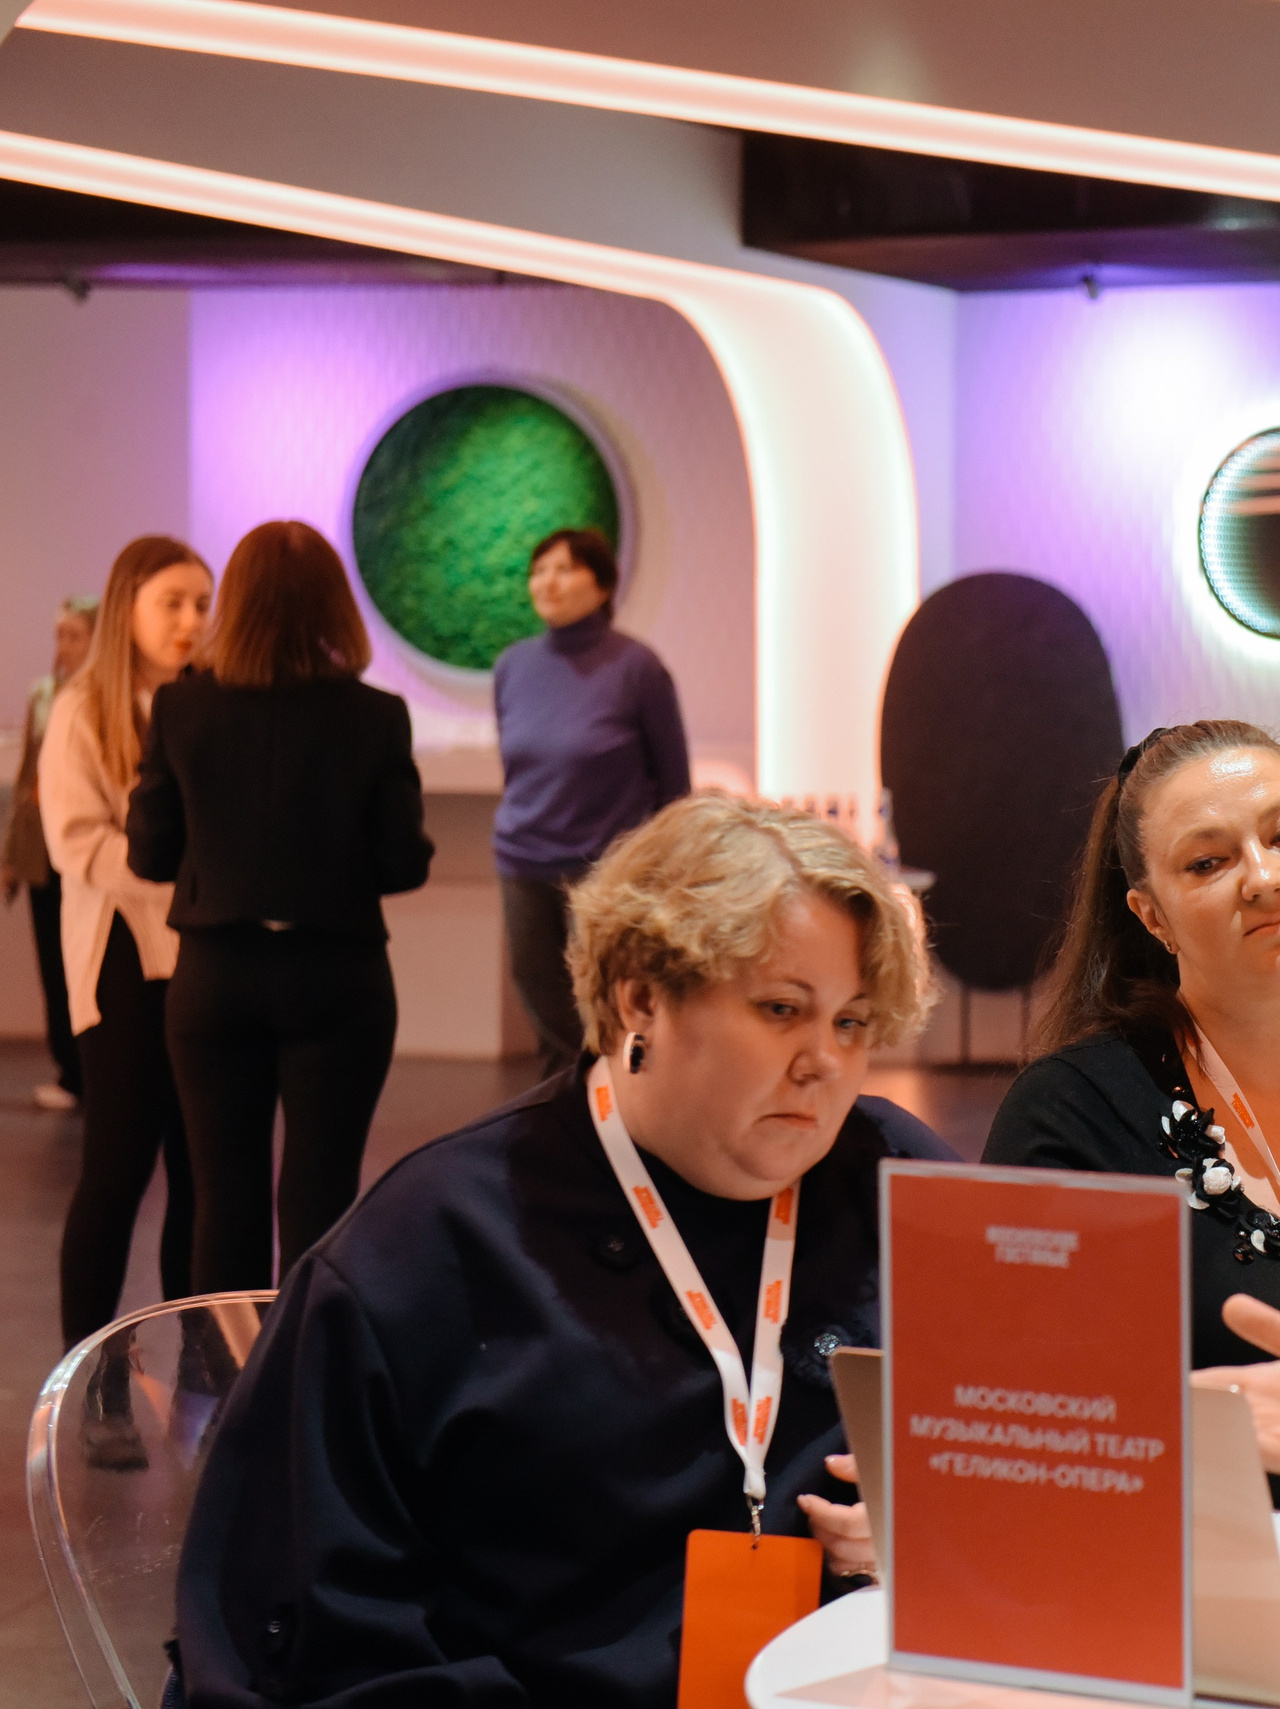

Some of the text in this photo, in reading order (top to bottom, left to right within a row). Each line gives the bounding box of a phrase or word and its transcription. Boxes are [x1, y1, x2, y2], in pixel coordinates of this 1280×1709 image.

[954, 1385, 1117, 1422] МОСКОВСКИЙ
[910, 1414, 1165, 1461] МУЗЫКАЛЬНЫЙ ТЕАТР
[929, 1451, 1144, 1495] «ГЕЛИКОН-ОПЕРА»
